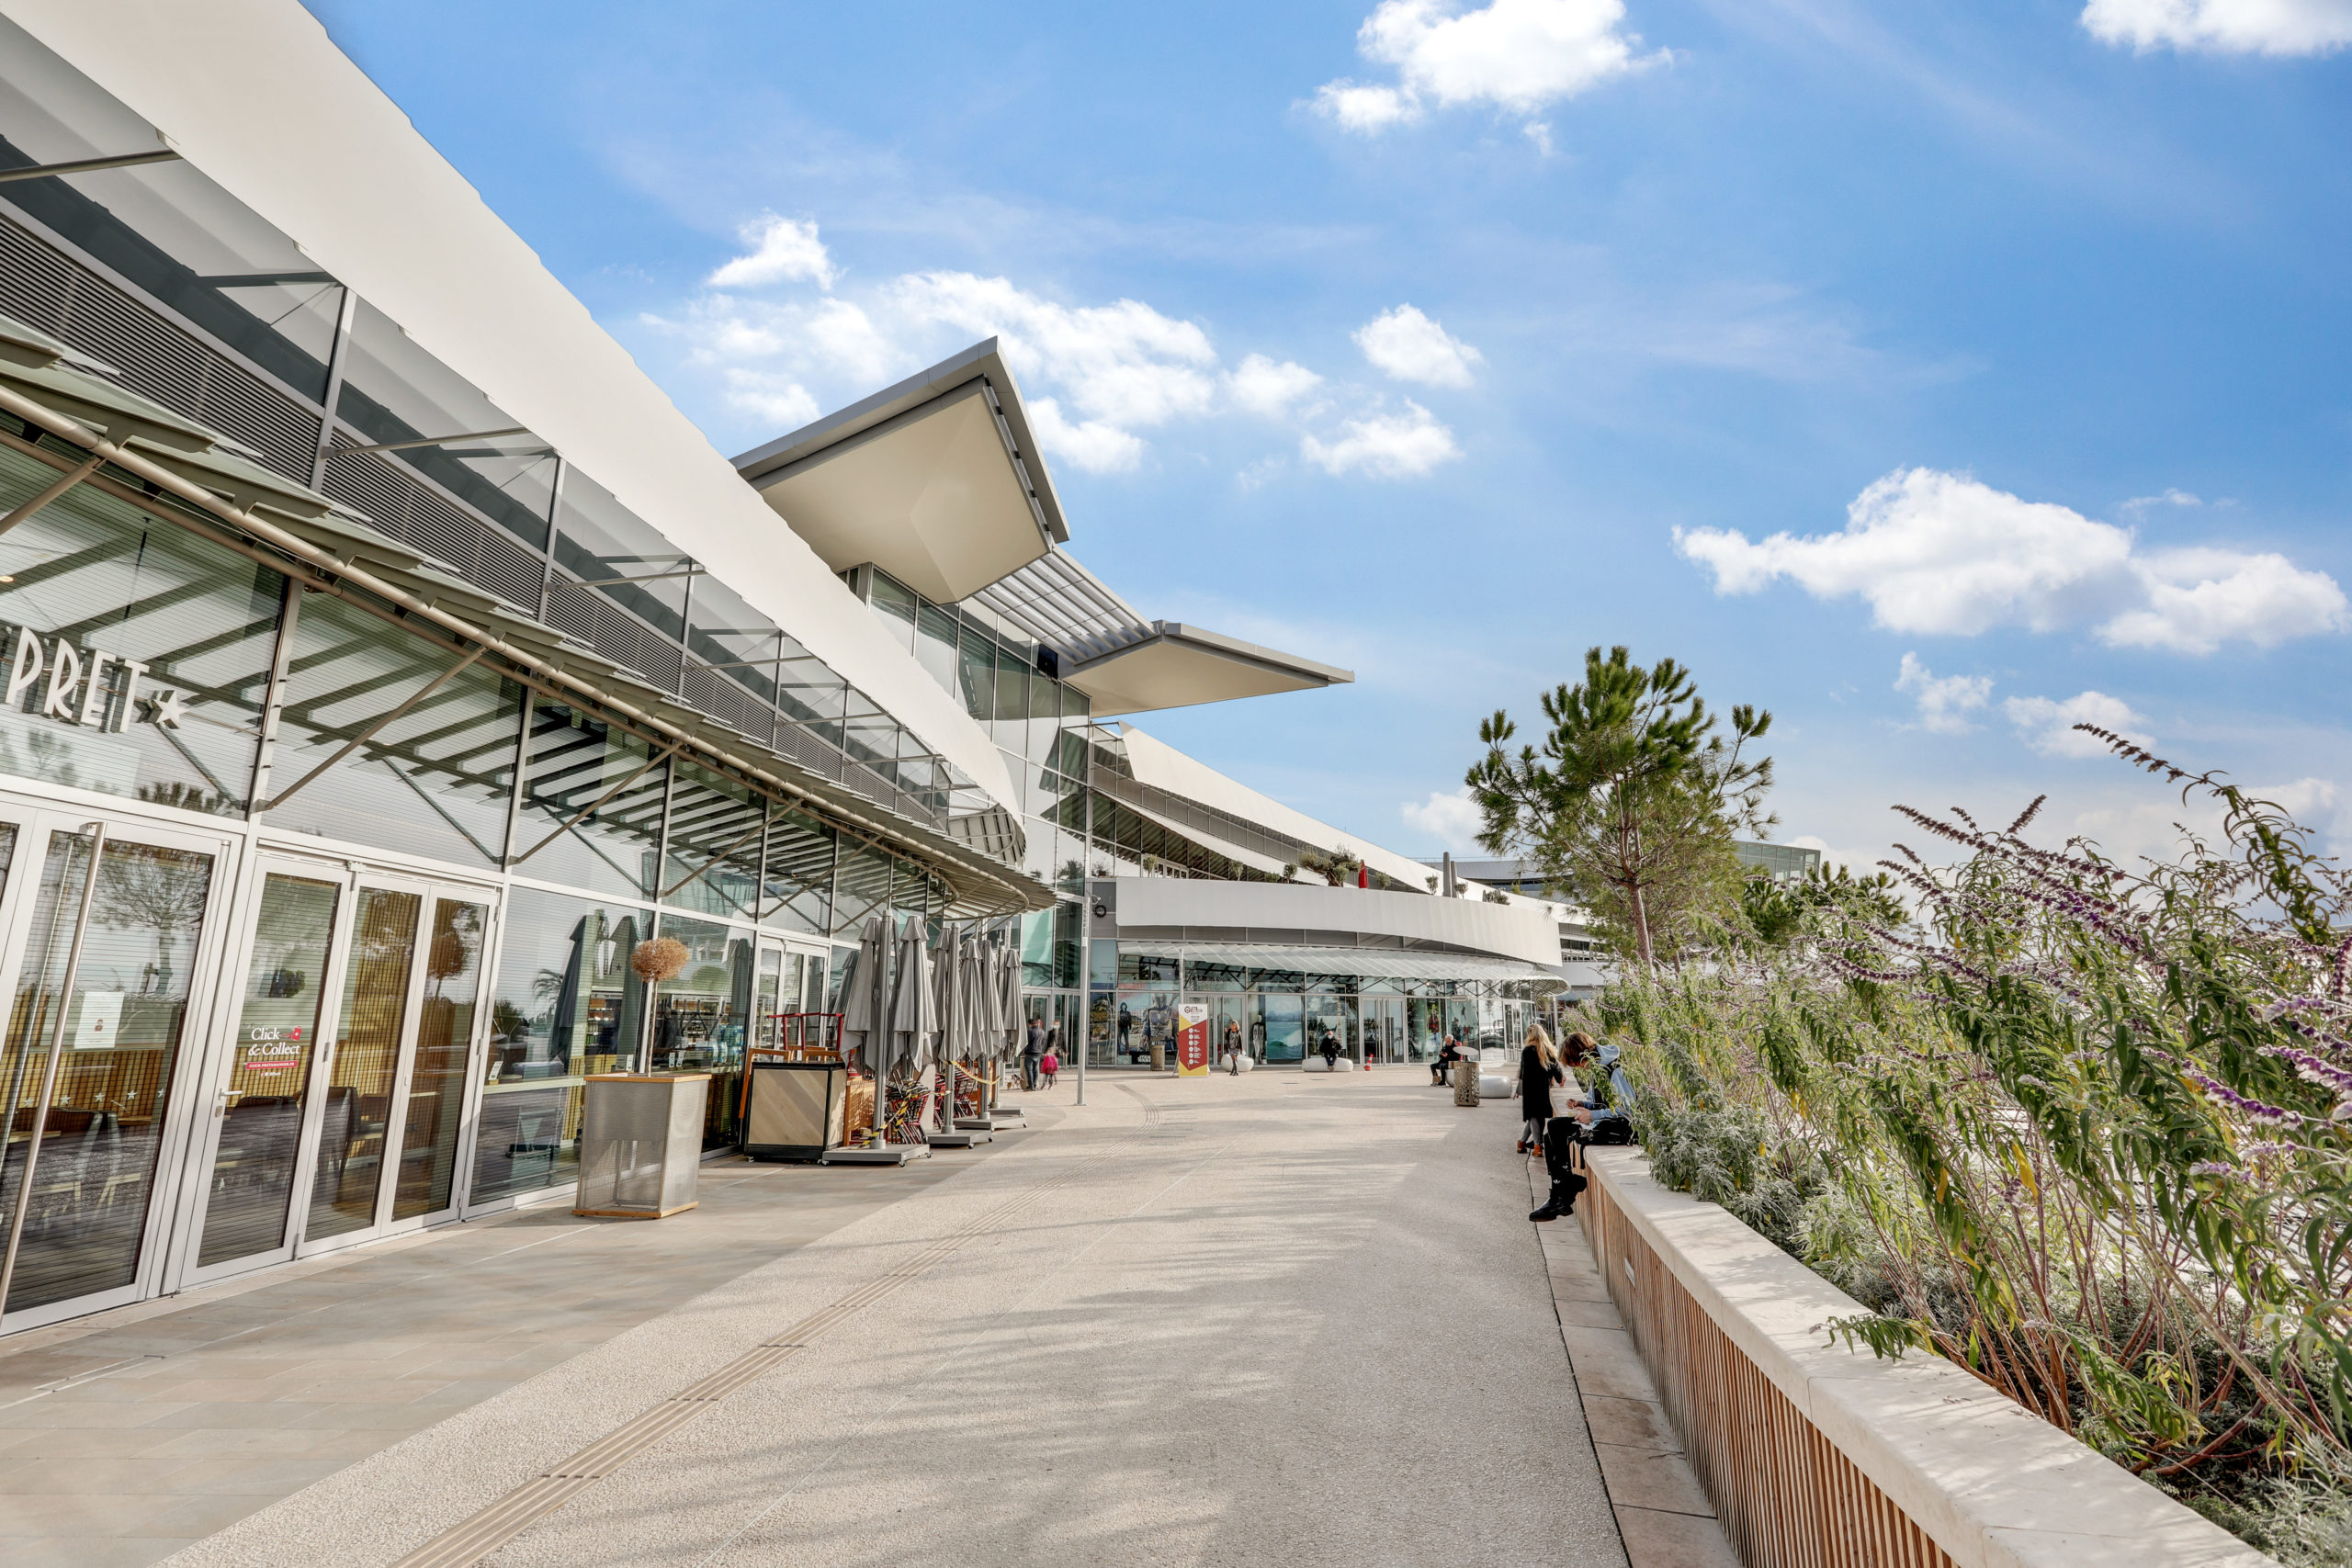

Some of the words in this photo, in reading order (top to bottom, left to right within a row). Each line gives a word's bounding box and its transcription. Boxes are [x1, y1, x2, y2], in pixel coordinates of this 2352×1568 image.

[5, 626, 151, 733] PRET
[251, 1027, 280, 1041] Click
[248, 1043, 260, 1056] &
[262, 1042, 300, 1055] Collect
